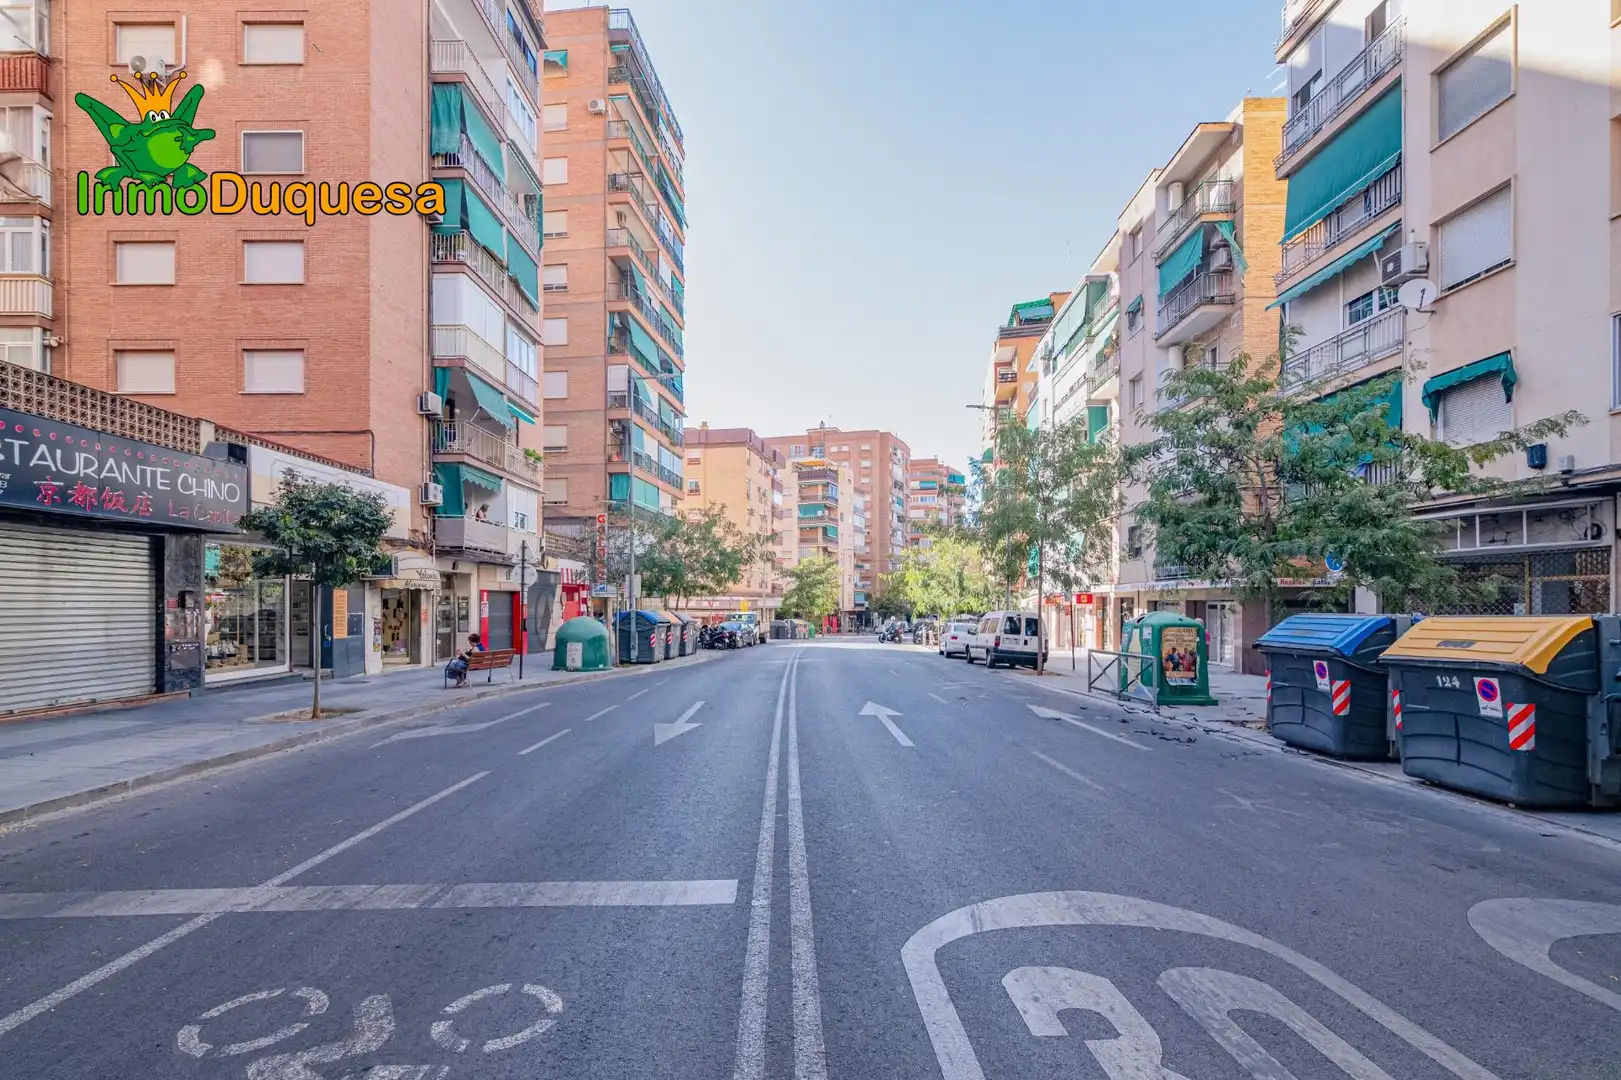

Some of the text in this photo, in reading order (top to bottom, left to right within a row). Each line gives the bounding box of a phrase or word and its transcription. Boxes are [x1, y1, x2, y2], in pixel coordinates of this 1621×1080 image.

[0, 438, 171, 491] TAURANTE
[177, 472, 240, 503] CHINO
[168, 499, 190, 520] La
[1436, 675, 1460, 689] 124
